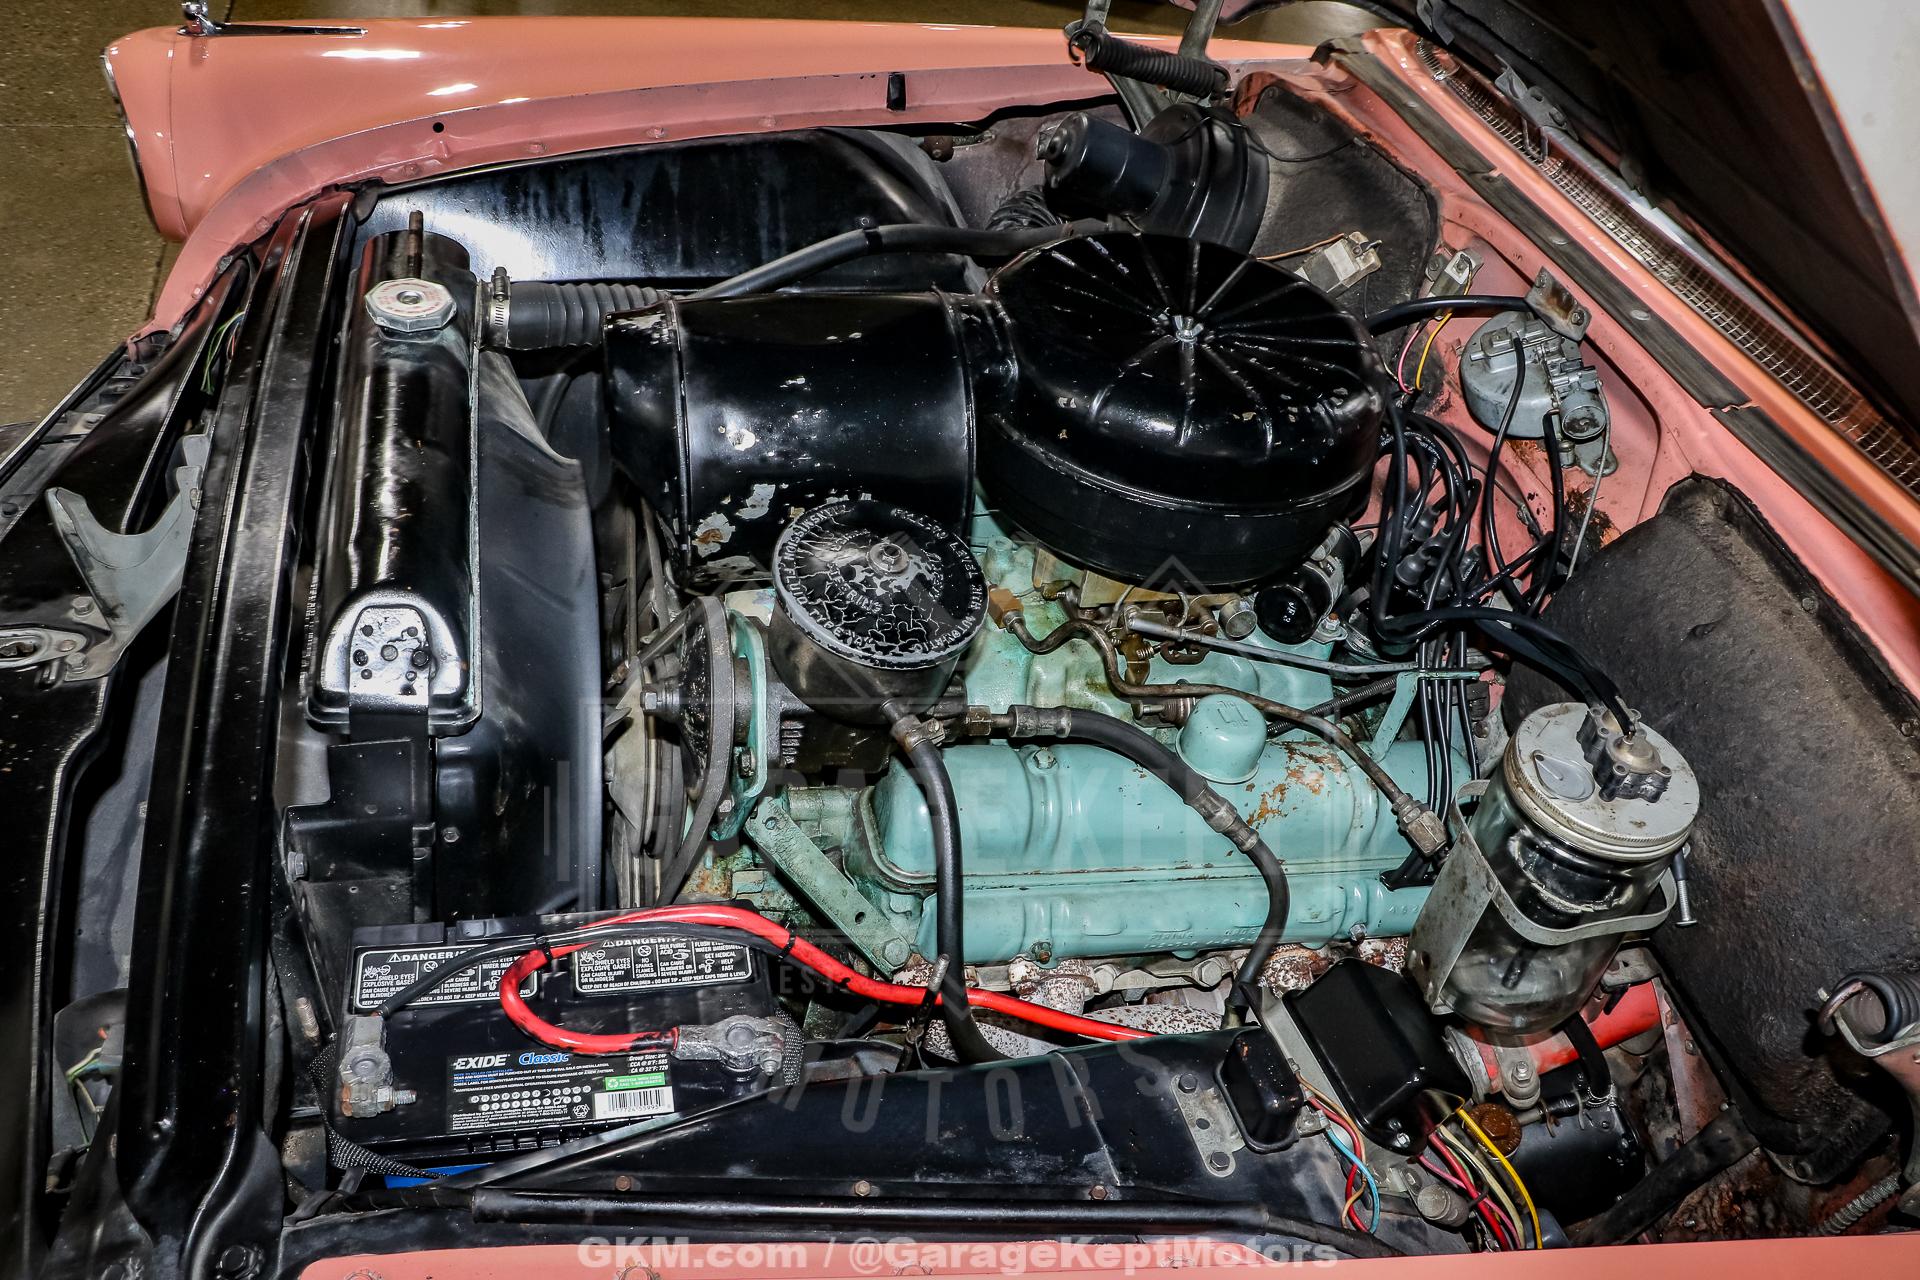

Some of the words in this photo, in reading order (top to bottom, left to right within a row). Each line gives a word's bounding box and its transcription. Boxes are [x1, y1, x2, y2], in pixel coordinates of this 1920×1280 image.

[809, 608, 843, 638] TYPE
[453, 1053, 507, 1070] EXIDE
[518, 1052, 569, 1066] Classic
